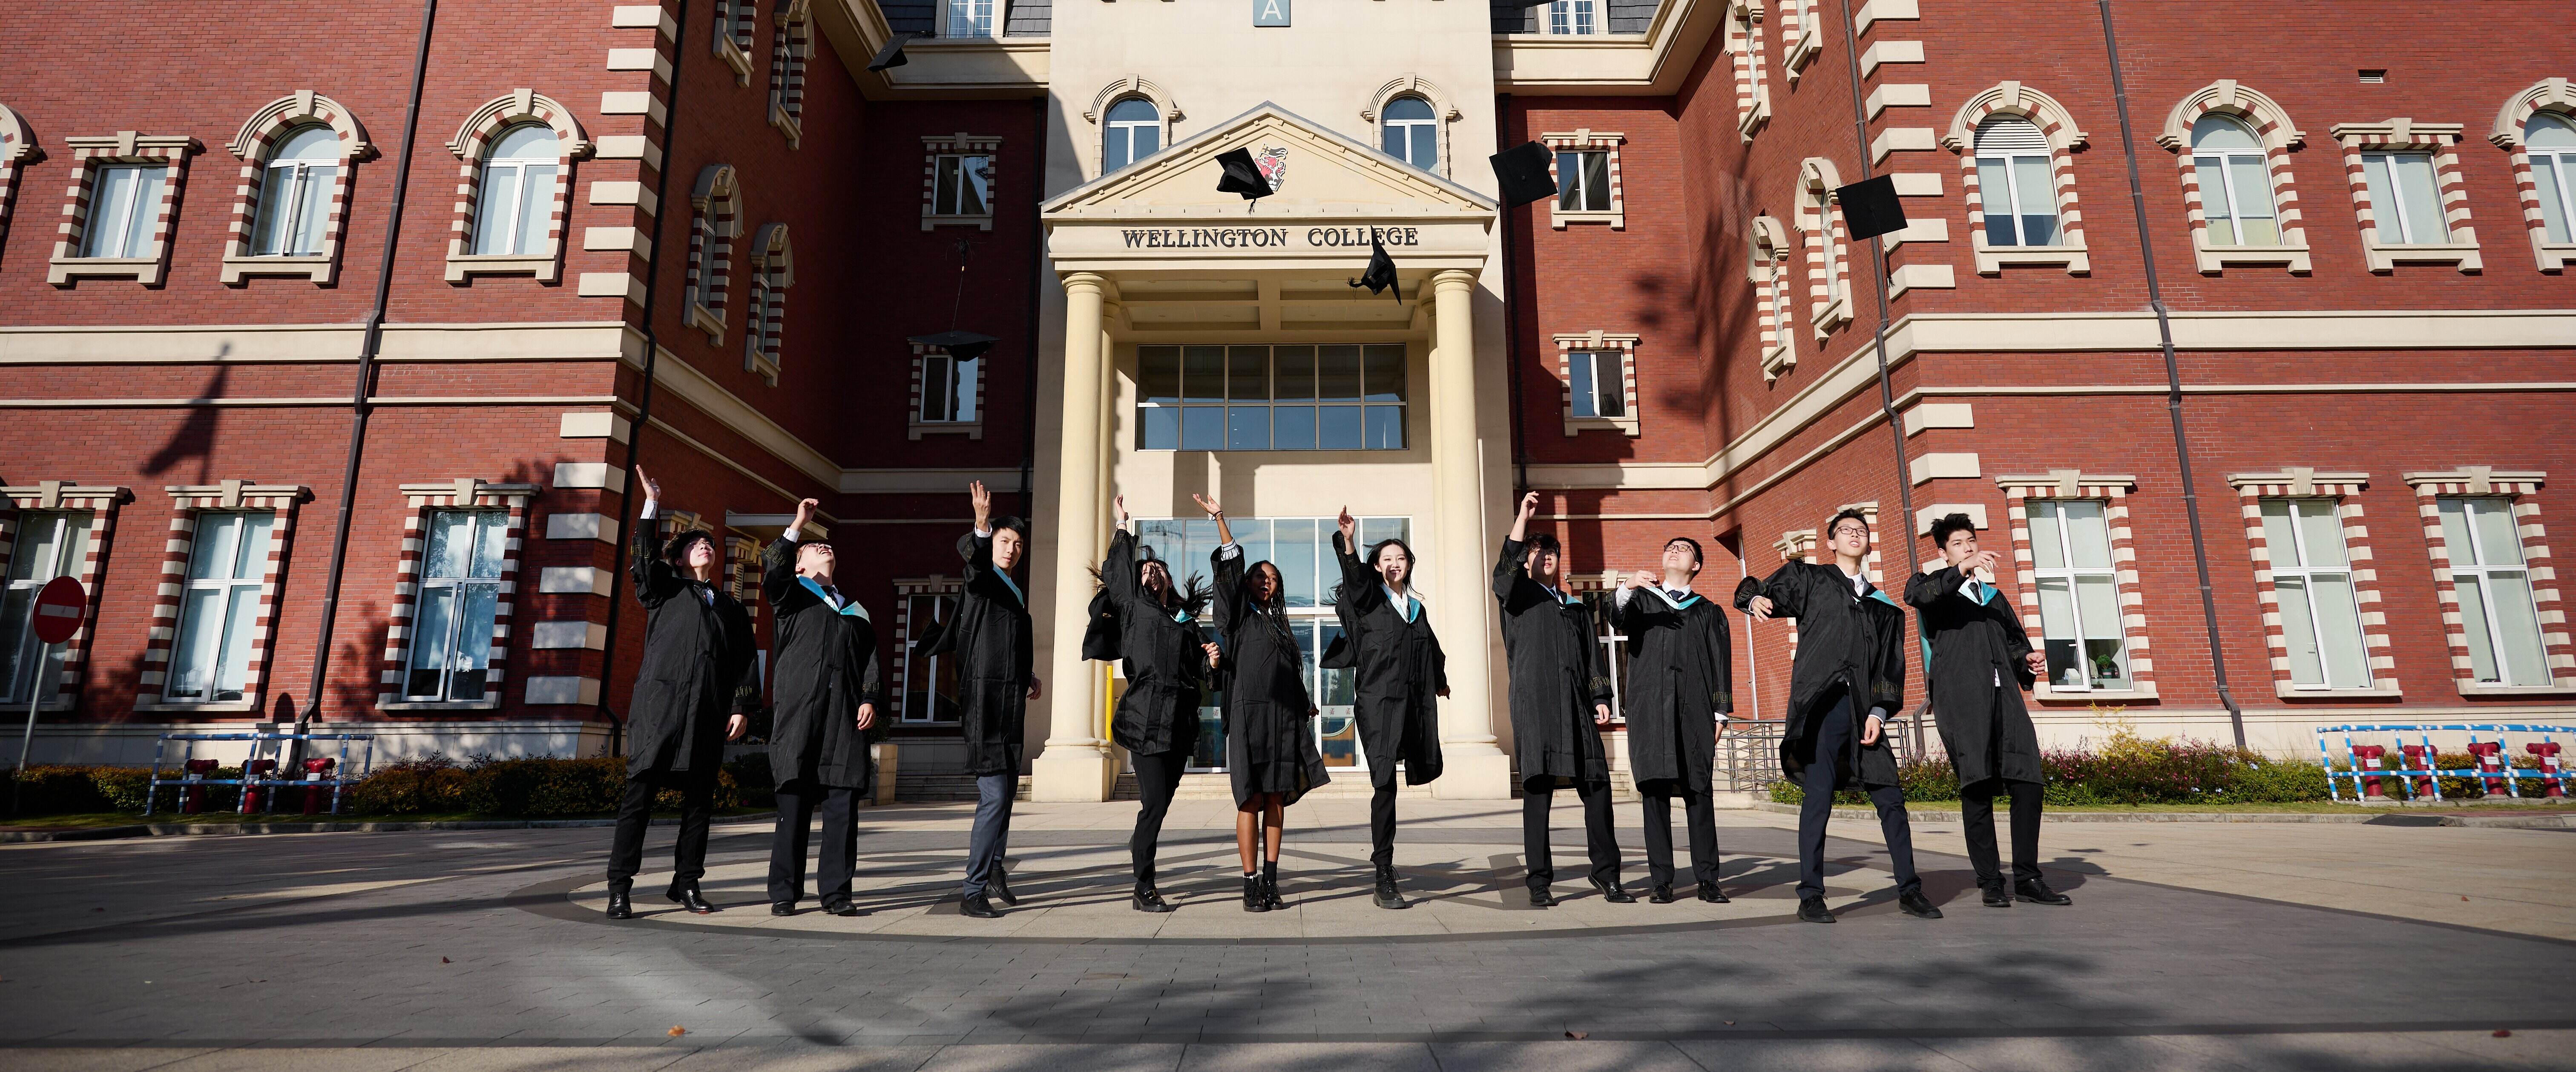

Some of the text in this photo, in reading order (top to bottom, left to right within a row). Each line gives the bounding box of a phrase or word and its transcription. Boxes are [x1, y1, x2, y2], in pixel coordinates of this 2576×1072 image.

[1261, 0, 1282, 20] A
[1121, 227, 1418, 248] WELLINGTON COLLEGE
